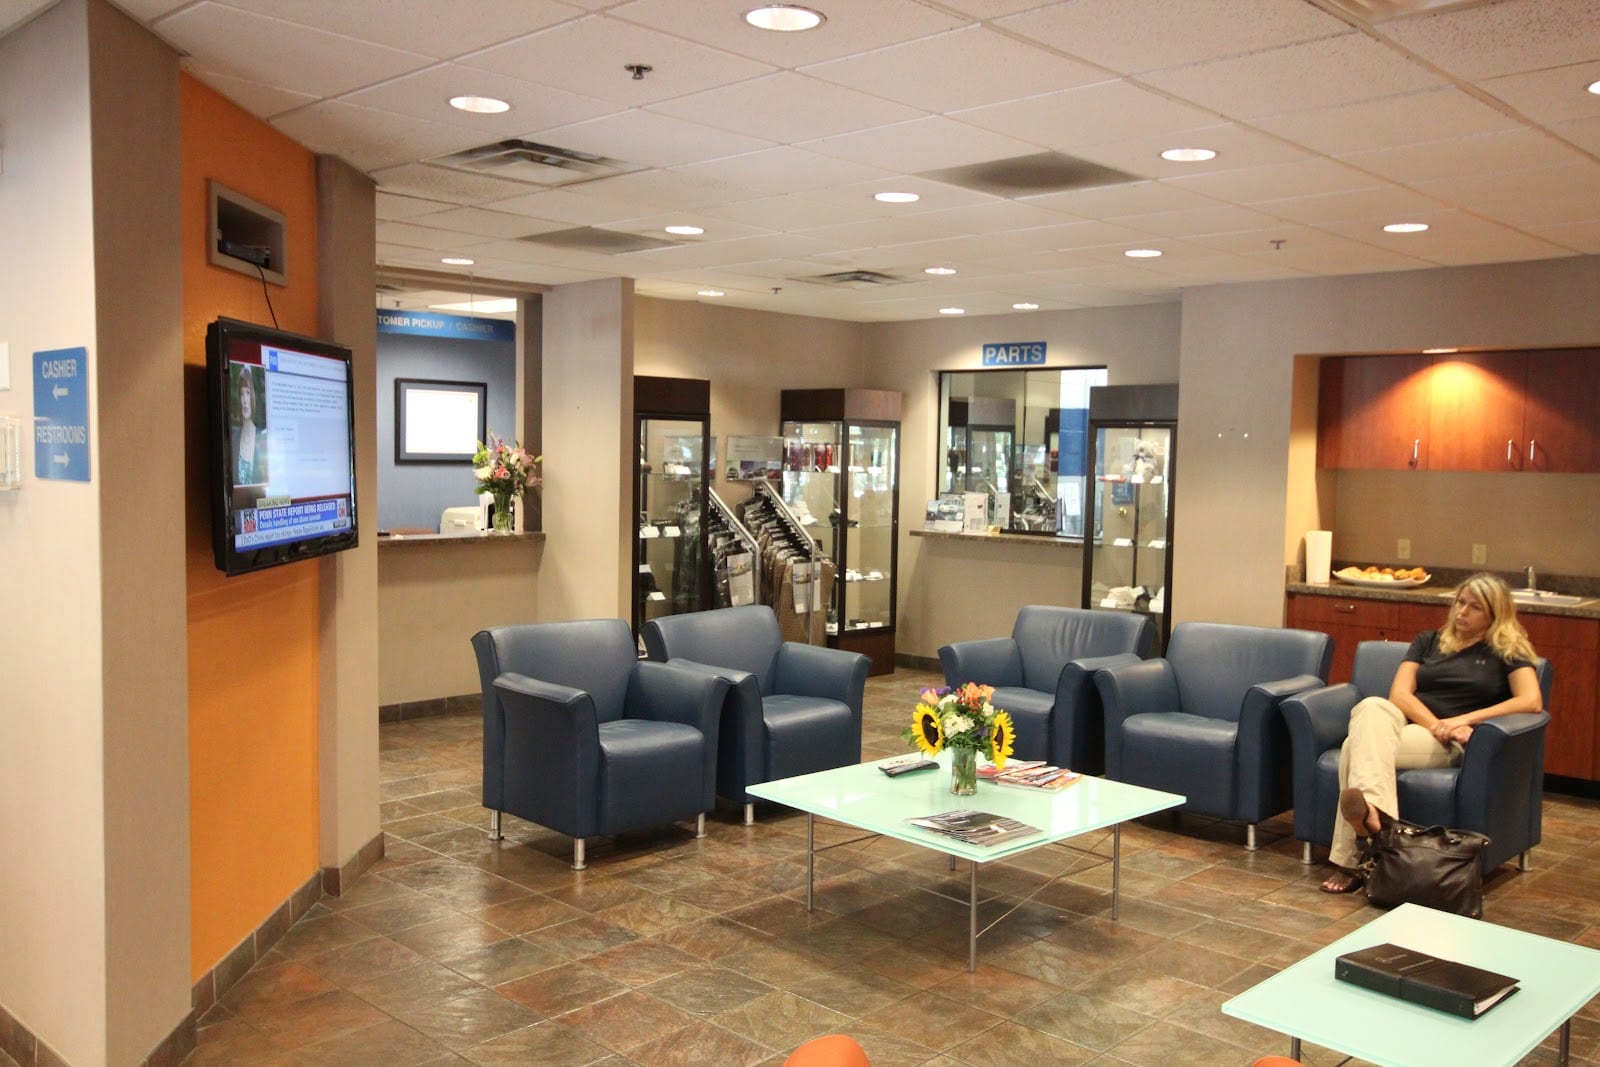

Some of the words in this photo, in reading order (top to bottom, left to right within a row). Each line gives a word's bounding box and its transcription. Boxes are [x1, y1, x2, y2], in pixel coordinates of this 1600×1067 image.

[377, 315, 410, 327] TOMER
[412, 318, 445, 329] PICKUP
[456, 322, 494, 334] CASHIER
[985, 345, 1042, 363] PARTS
[42, 359, 77, 379] CASHIER
[36, 426, 86, 444] RESTROOMS
[273, 508, 287, 518] STATE
